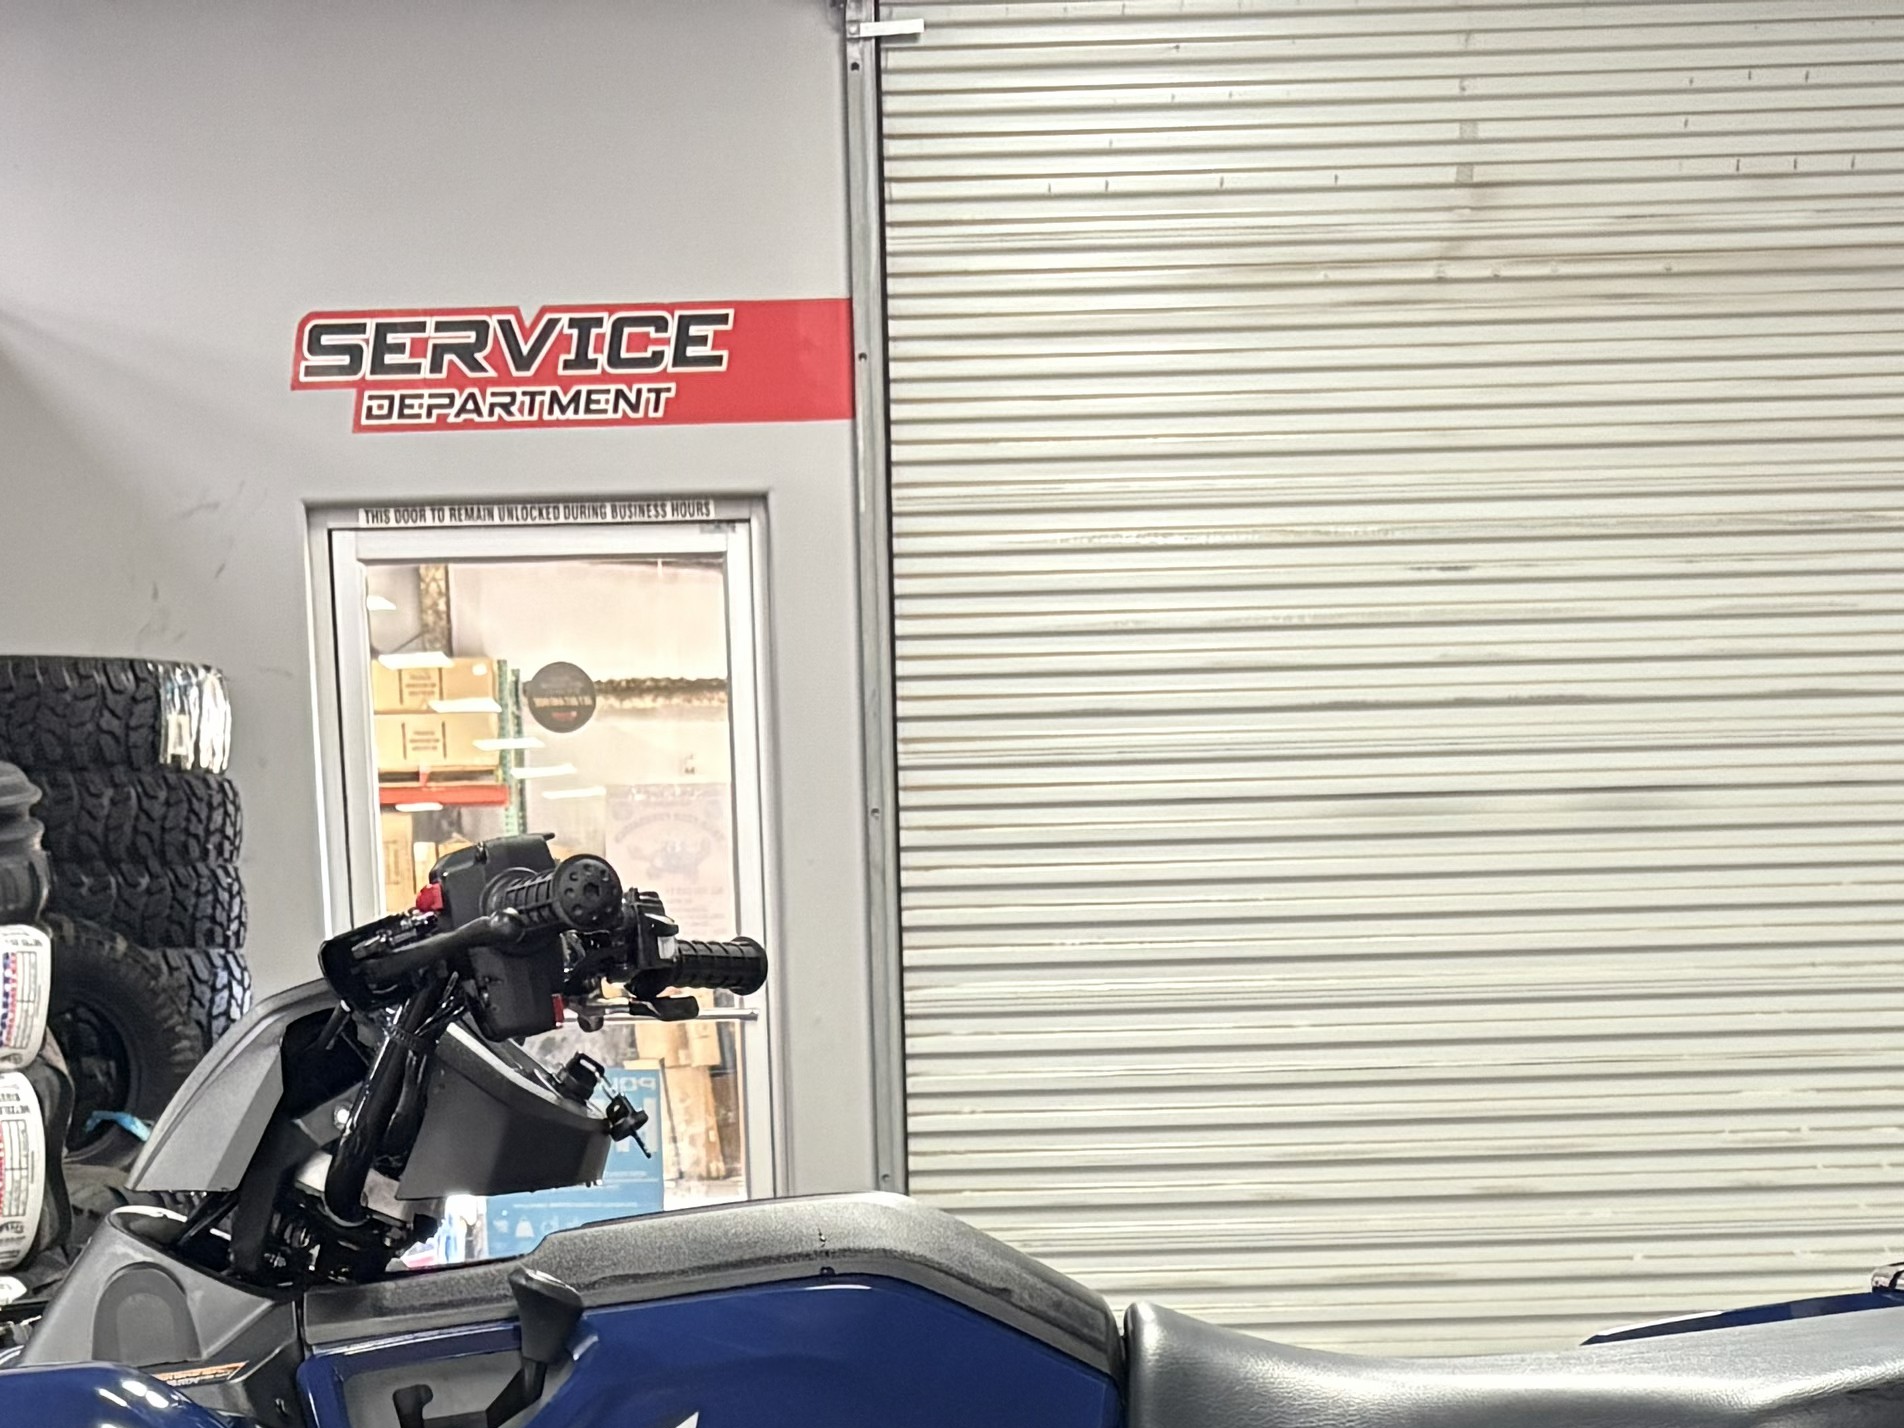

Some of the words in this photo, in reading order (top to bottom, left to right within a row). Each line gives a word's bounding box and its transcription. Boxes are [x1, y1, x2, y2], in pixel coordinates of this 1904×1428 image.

[300, 308, 733, 381] SERVICE
[361, 383, 676, 425] DEPARTMENT
[365, 508, 391, 524] THIS
[395, 507, 427, 524] DOOR
[430, 506, 446, 523] TO
[449, 504, 495, 523] REMAIN
[498, 503, 561, 522] UNLOCKED
[563, 502, 607, 520] DURING
[611, 501, 667, 519] BUSINESS
[671, 500, 711, 518] HOURS
